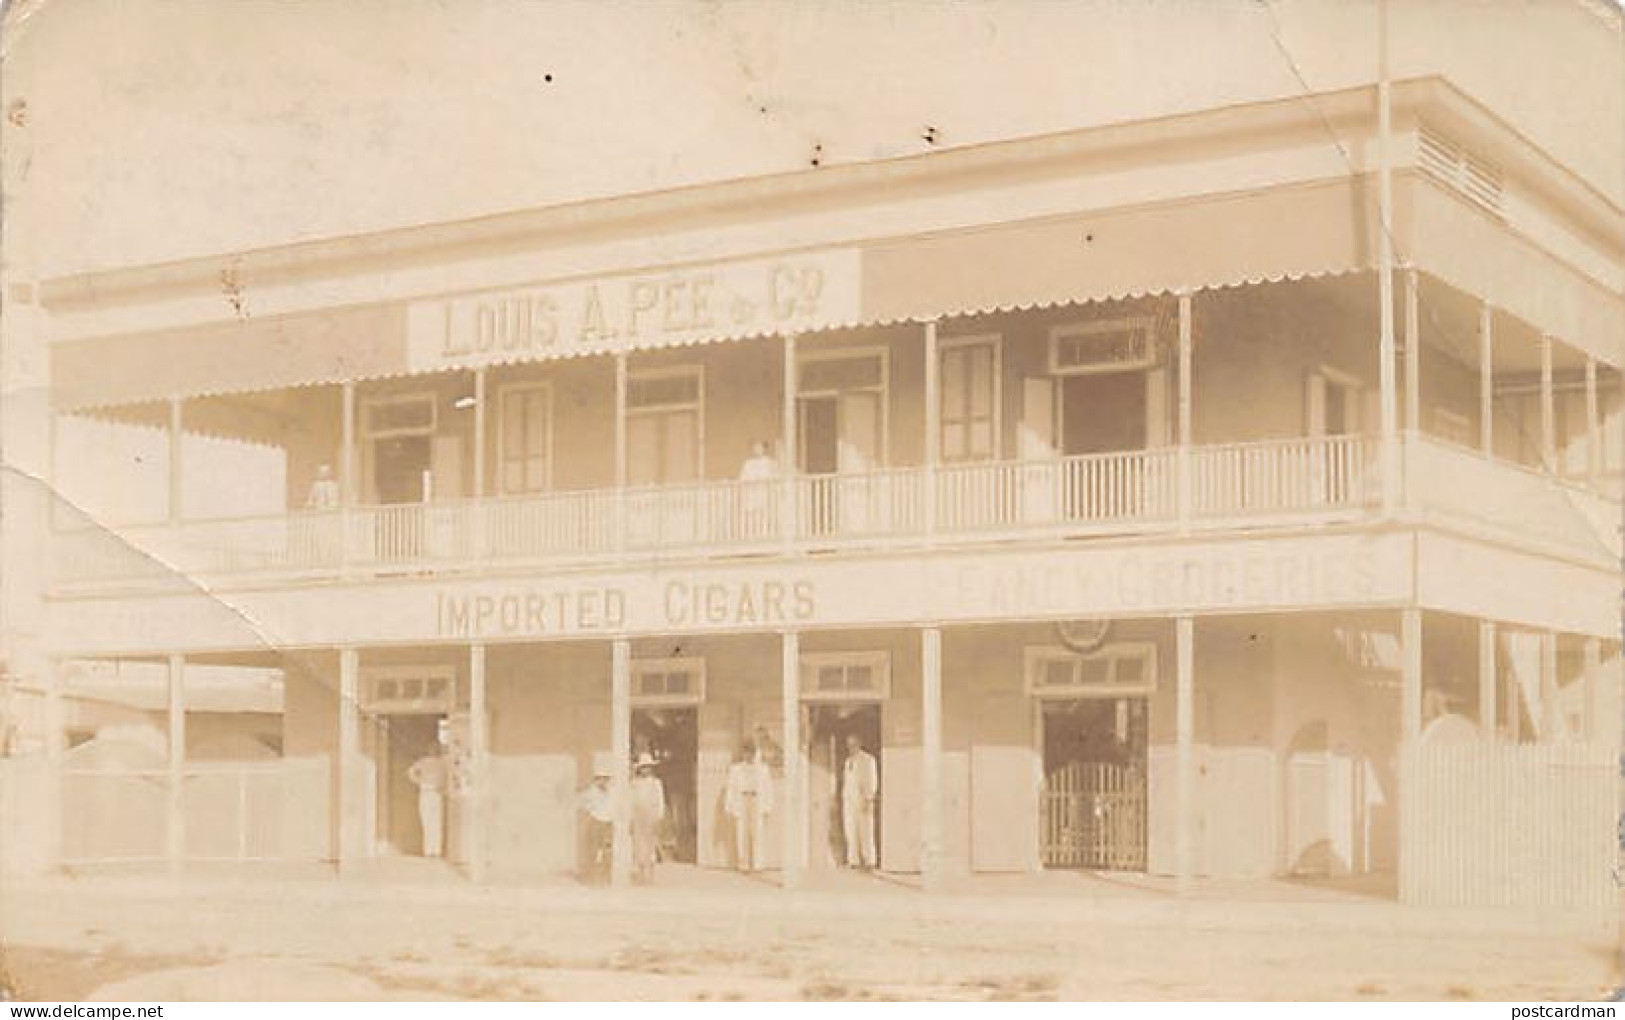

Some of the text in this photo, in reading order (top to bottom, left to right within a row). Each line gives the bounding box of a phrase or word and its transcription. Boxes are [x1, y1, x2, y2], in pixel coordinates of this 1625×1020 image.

[441, 294, 558, 357] LOUIS
[436, 580, 816, 637] IMPORTED CIGARS
